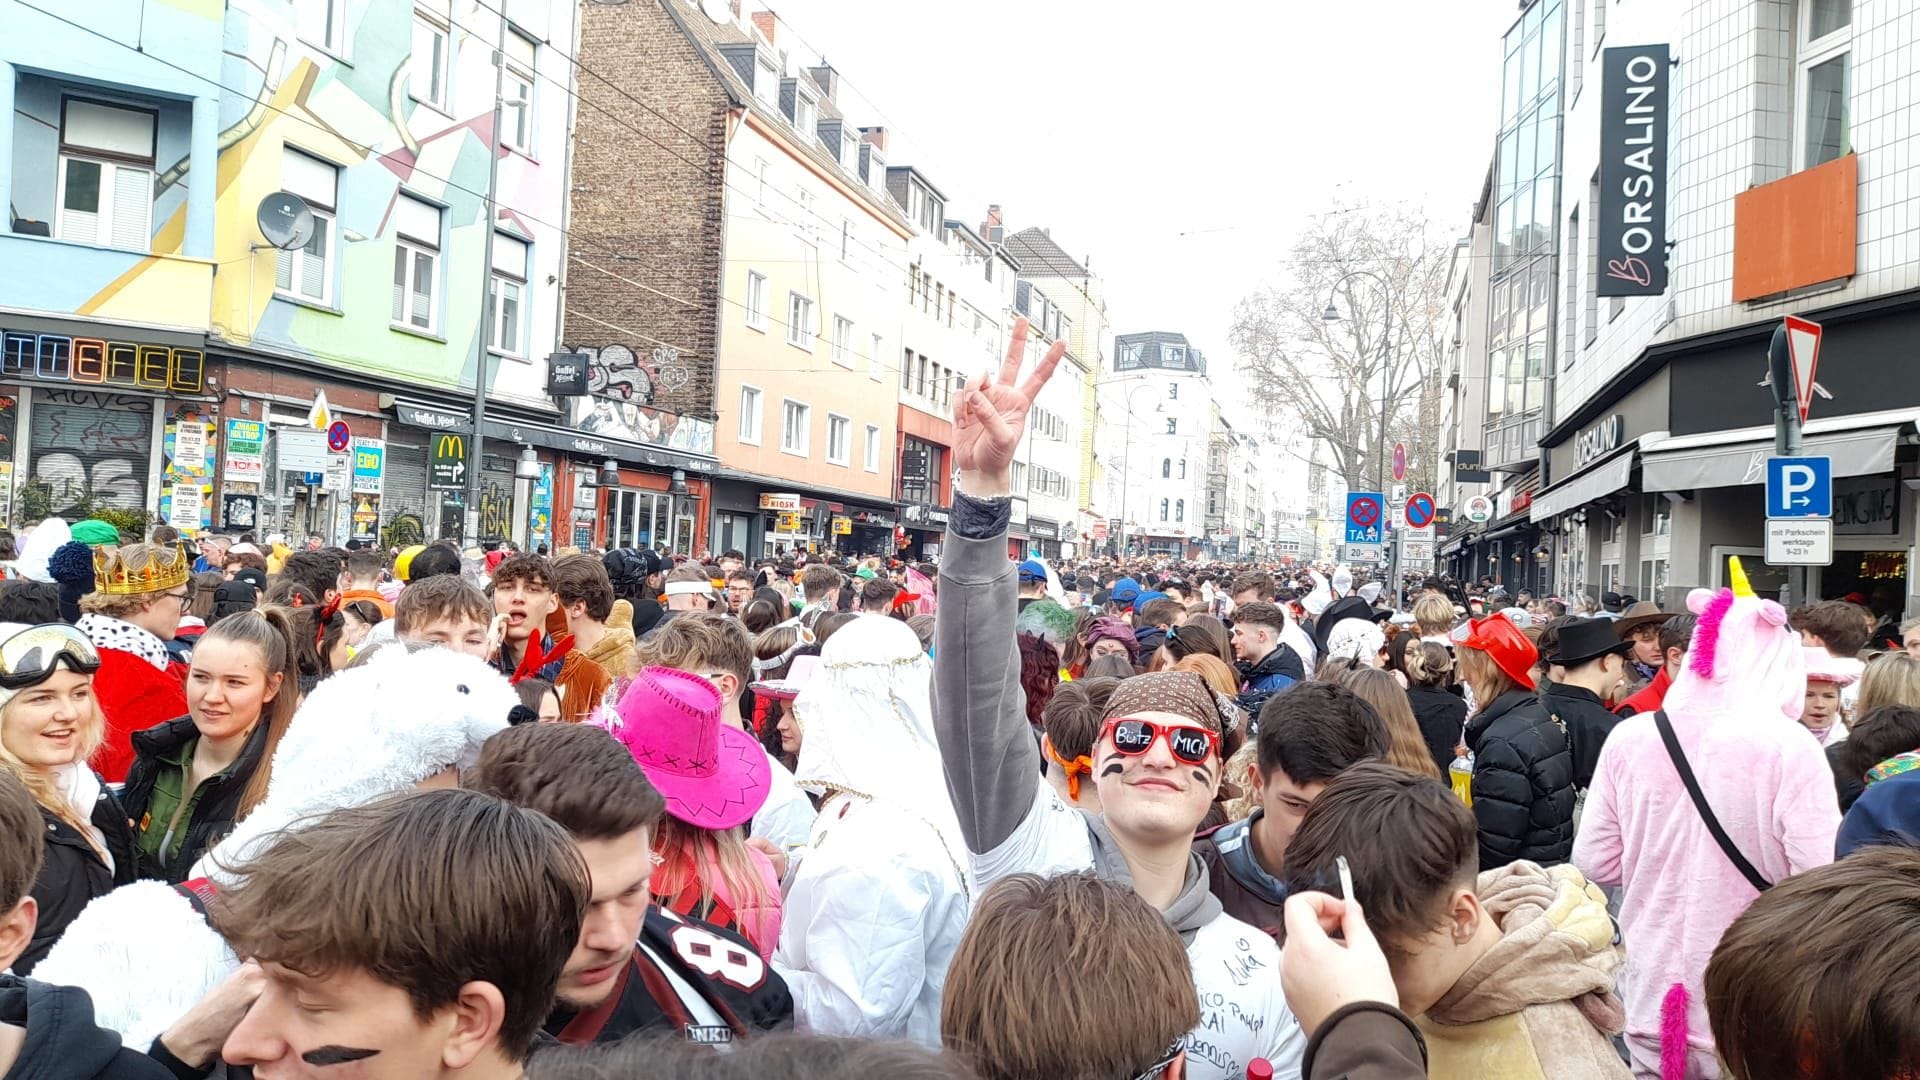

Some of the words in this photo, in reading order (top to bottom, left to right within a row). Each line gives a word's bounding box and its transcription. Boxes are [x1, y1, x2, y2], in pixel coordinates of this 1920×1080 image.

[1607, 56, 1656, 286] BORSALINO
[357, 452, 379, 469] EGO
[1781, 465, 1816, 510] P
[770, 501, 795, 509] KIOSK
[1782, 539, 1815, 547] werktags
[1173, 735, 1206, 756] MICH
